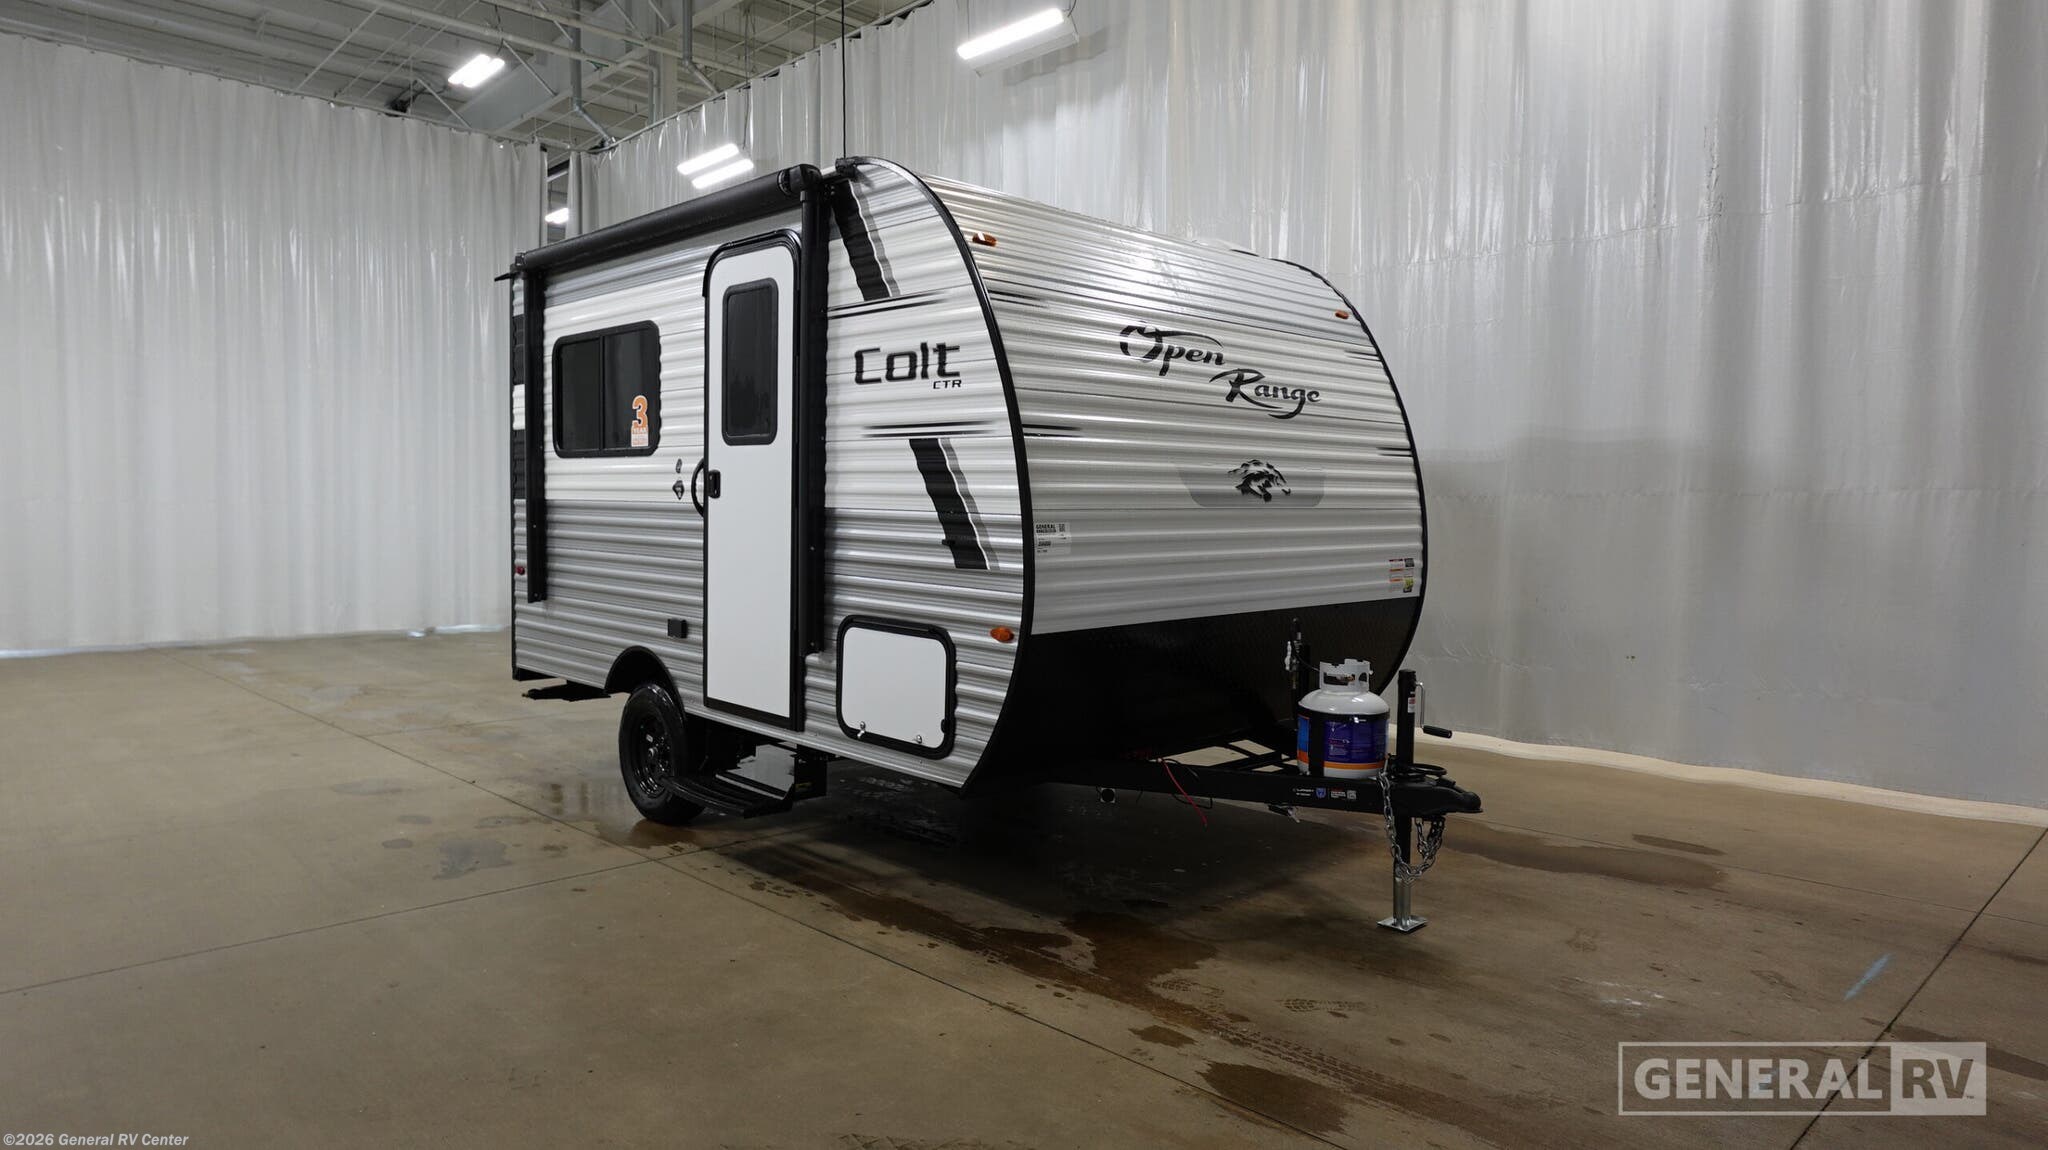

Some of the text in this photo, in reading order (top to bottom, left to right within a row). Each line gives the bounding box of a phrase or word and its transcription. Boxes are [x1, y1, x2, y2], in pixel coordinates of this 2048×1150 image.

[854, 342, 960, 385] Colt
[1119, 321, 1225, 376] Open
[933, 380, 962, 389] CTR
[1209, 368, 1321, 419] Range
[632, 395, 648, 428] 3
